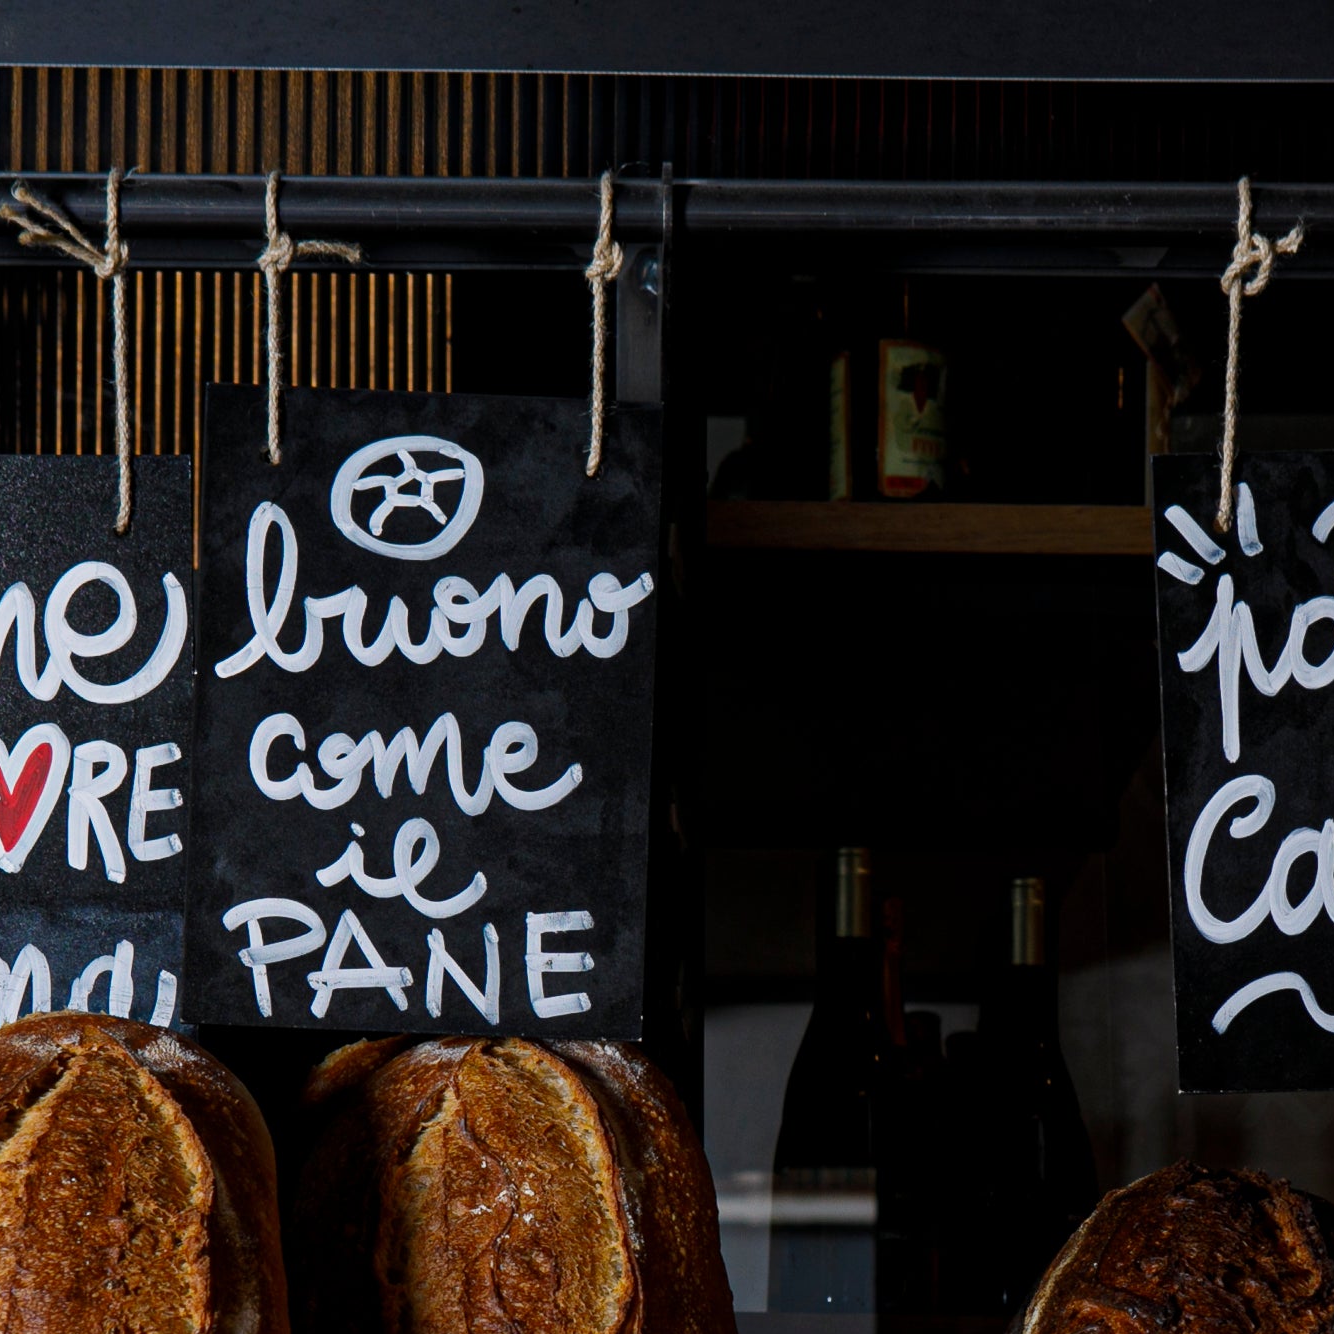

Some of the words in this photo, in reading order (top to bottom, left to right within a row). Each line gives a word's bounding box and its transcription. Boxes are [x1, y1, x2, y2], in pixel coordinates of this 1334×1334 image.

[215, 501, 654, 678] buono
[249, 712, 583, 815] come
[223, 898, 595, 1018] PANE
